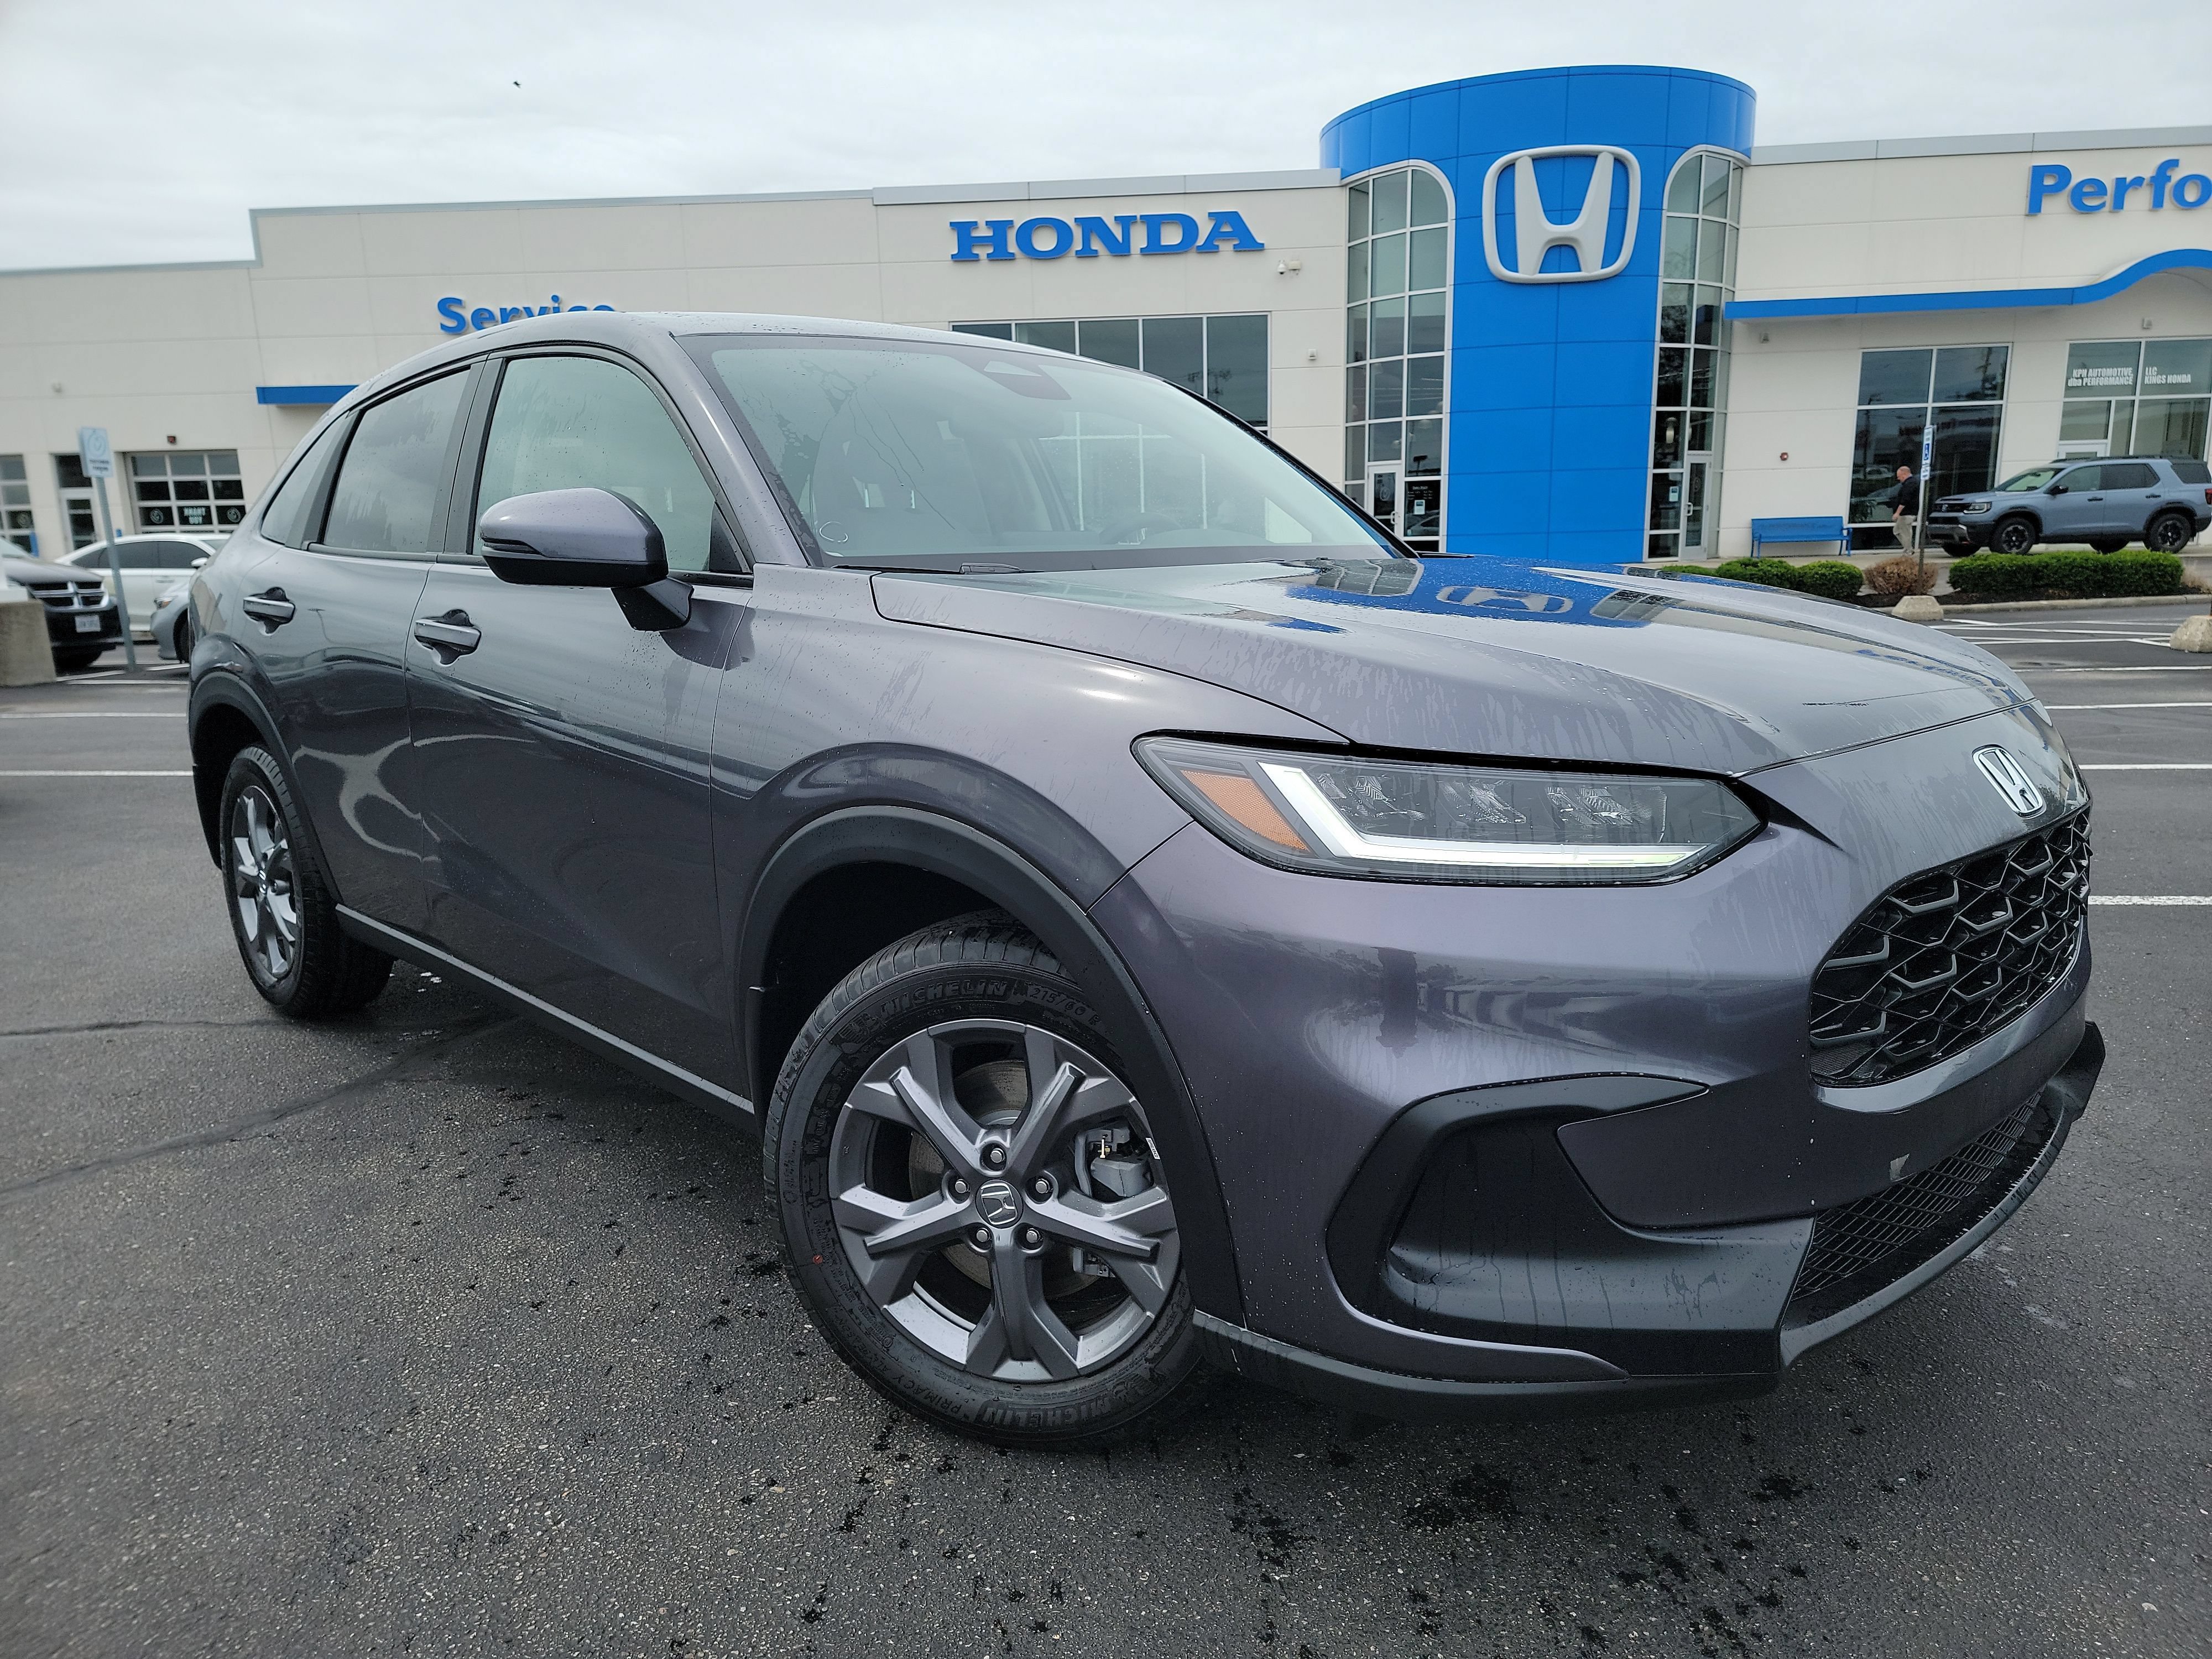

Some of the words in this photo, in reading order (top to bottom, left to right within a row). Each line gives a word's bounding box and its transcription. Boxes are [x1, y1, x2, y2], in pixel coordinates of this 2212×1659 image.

[950, 211, 1265, 261] HONDA
[2083, 376, 2133, 387] PERFORMANCE
[2145, 374, 2166, 384] KINGS
[2167, 373, 2192, 384] HONDA
[2145, 366, 2157, 375] LLC
[881, 979, 1008, 1018] MICHELIN
[1029, 986, 1086, 1017] 215/60
[892, 1374, 962, 1415] PRIMACY
[981, 1397, 1109, 1427] MICHELIN
